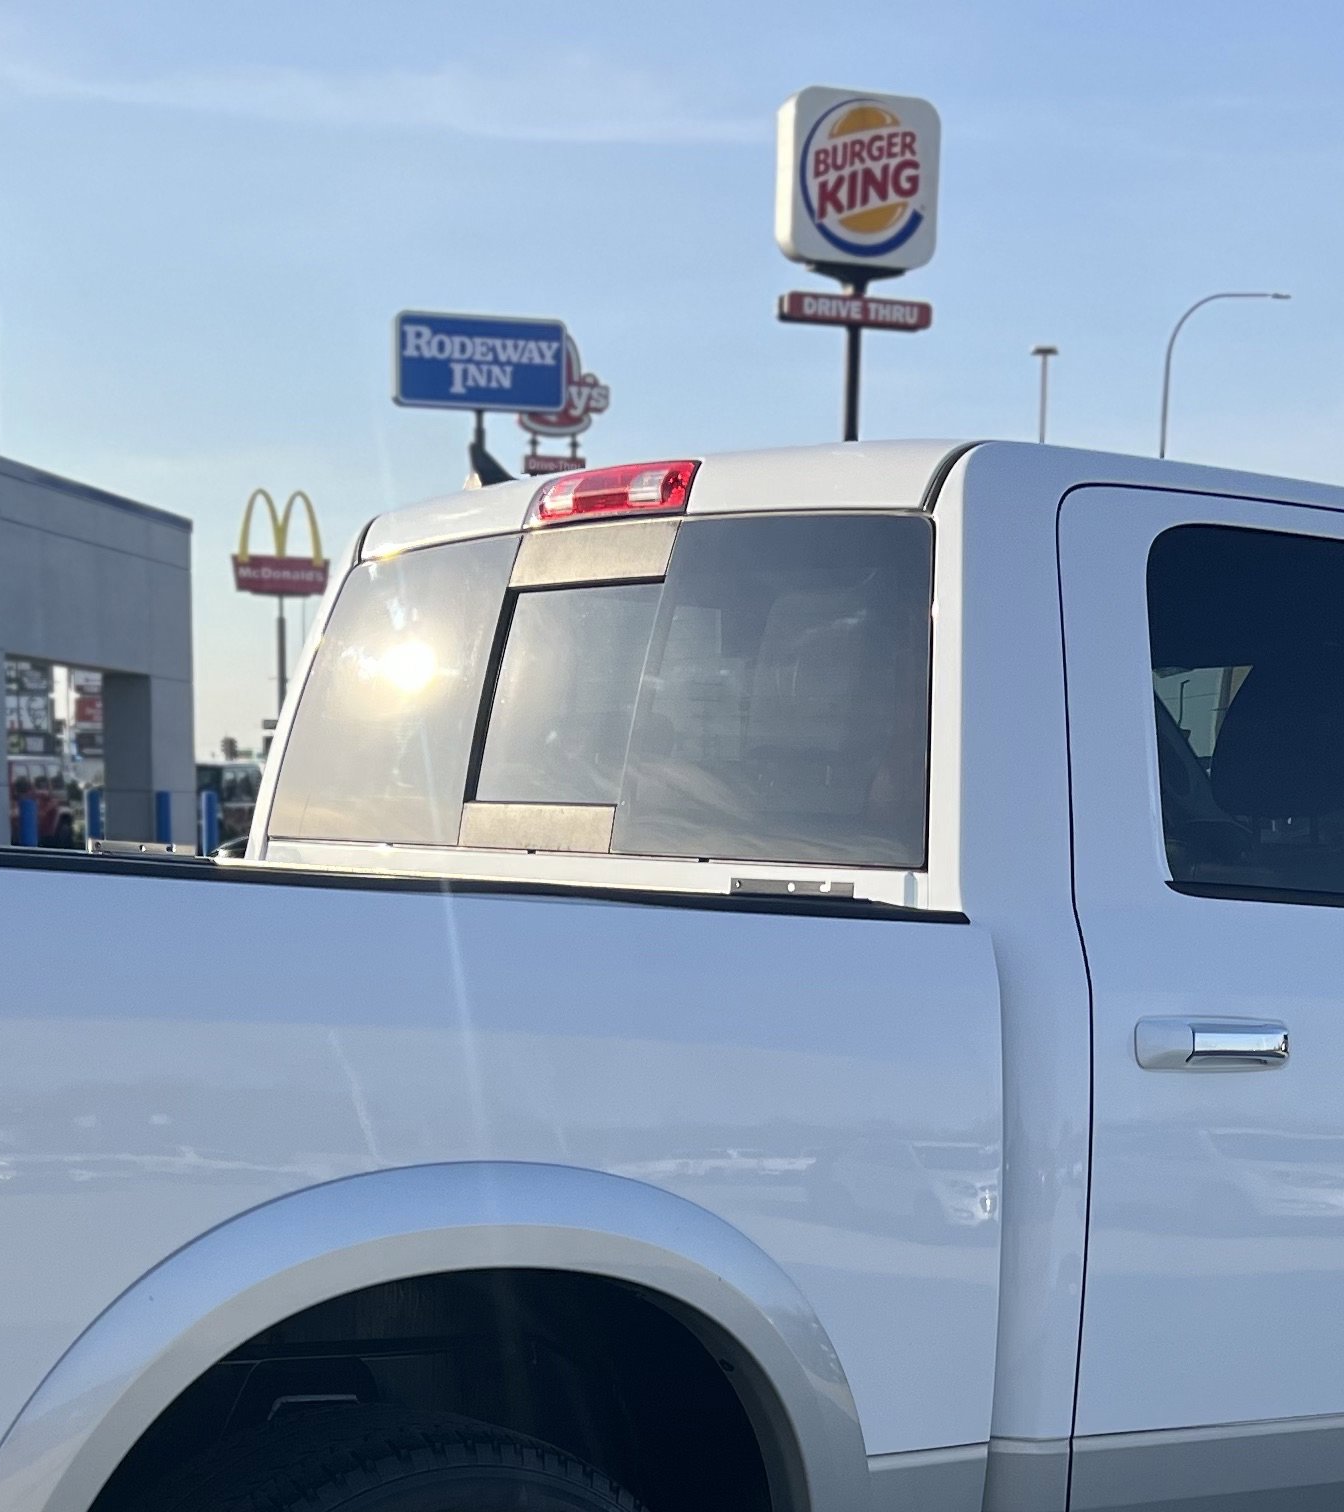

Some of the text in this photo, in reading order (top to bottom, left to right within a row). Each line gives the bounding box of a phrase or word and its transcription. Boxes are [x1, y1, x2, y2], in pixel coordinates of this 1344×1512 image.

[813, 131, 917, 179] BURGER
[816, 158, 920, 221] KING
[803, 297, 918, 324] DRIVE THRU
[403, 324, 560, 365] RODEWAY
[449, 363, 513, 393] INN
